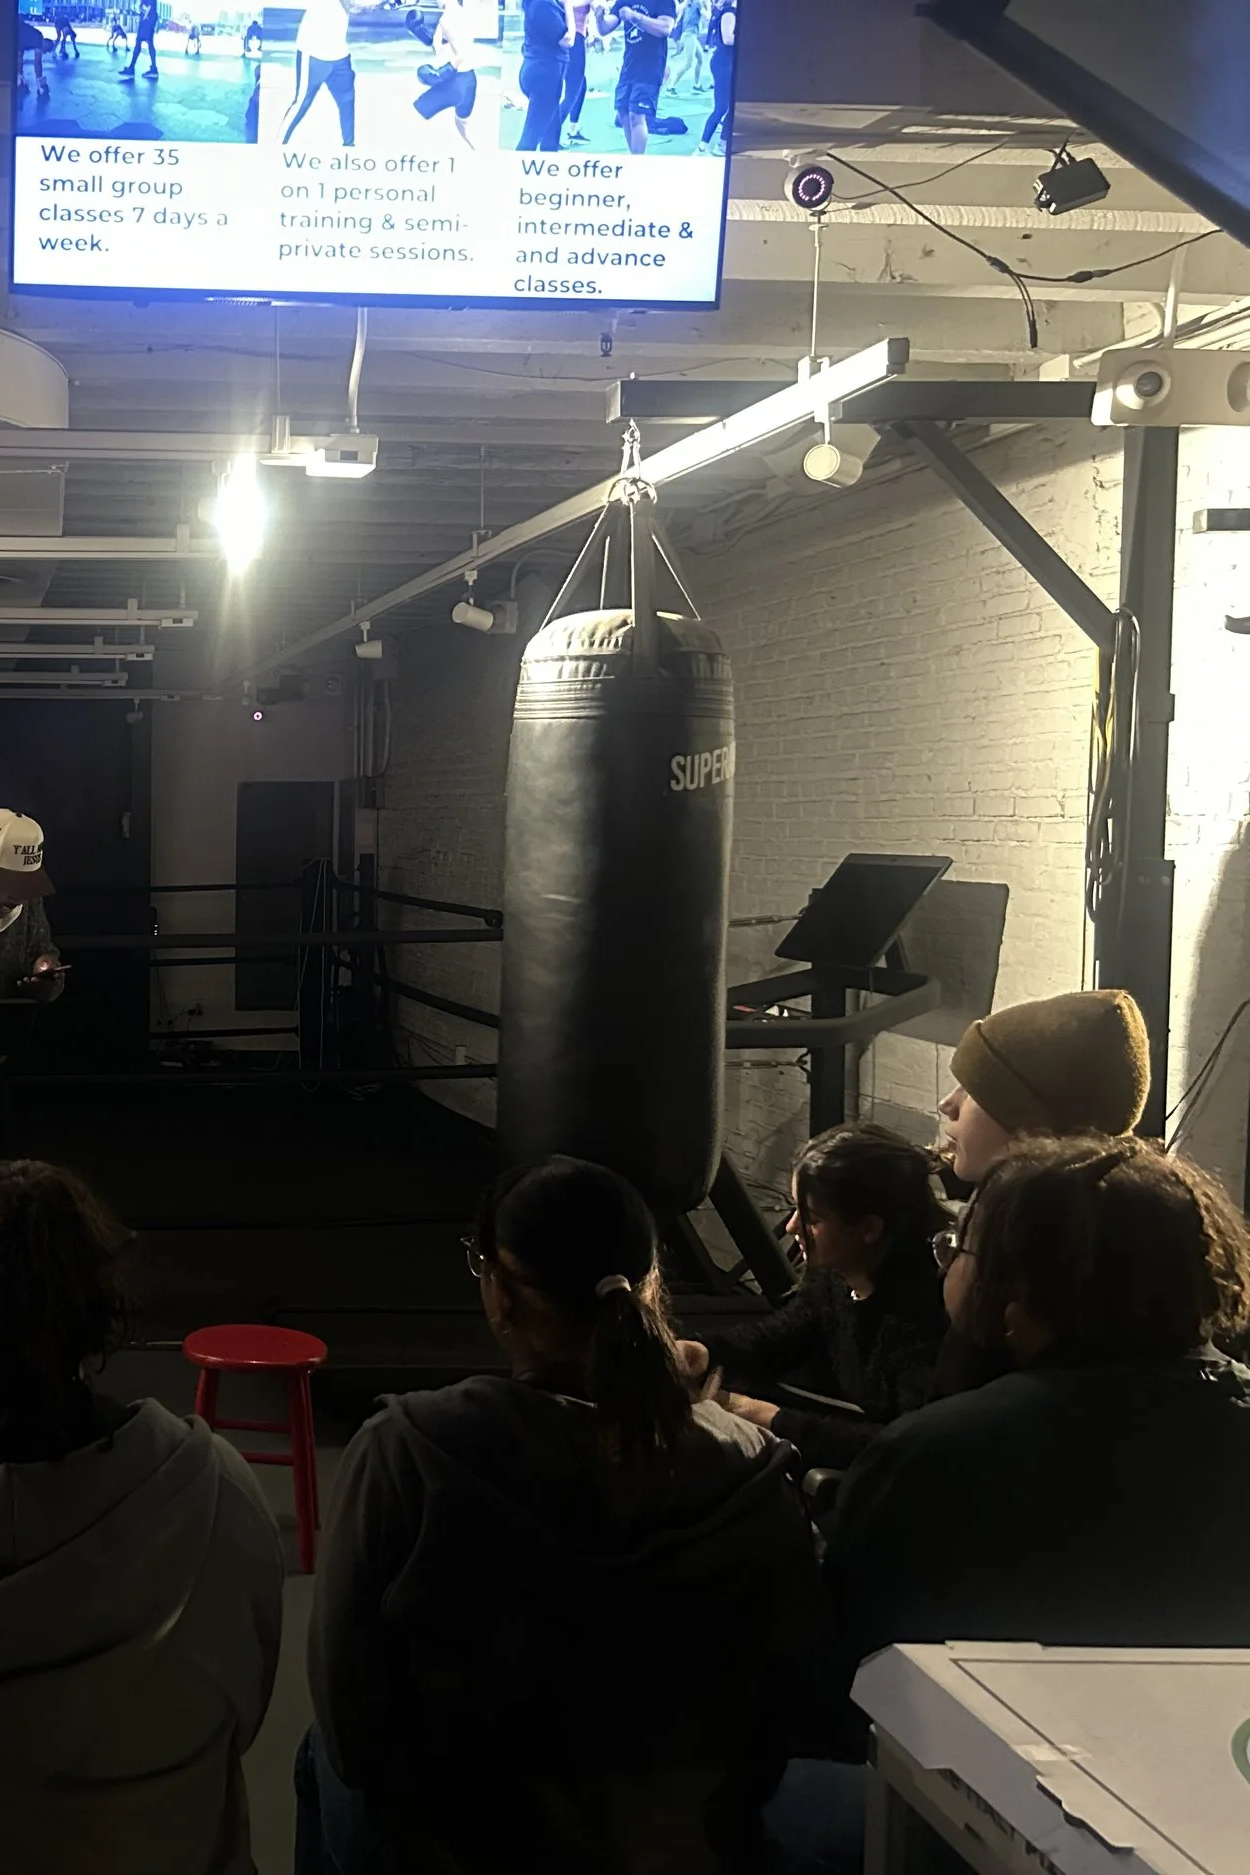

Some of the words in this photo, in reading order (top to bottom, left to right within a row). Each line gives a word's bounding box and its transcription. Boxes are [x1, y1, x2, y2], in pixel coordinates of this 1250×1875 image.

[40, 144, 82, 164] We
[88, 145, 146, 165] offer
[152, 148, 180, 166] 35
[282, 152, 322, 170] We
[329, 152, 377, 172] also
[384, 154, 441, 173] offer
[521, 159, 560, 177] We
[567, 159, 624, 180] offer
[39, 174, 103, 193] small
[111, 180, 183, 200] group
[280, 185, 309, 199] on
[317, 182, 325, 200] 1
[333, 184, 436, 205] personal
[518, 187, 631, 213] beginner,
[38, 202, 125, 224] classes
[131, 206, 146, 224] 7
[153, 206, 209, 230] days
[216, 213, 228, 227] a
[279, 209, 373, 235] training
[381, 213, 396, 231] &
[404, 213, 468, 233] semi-
[517, 215, 671, 239] intermediate
[677, 221, 694, 240] &
[38, 233, 110, 252] week.
[278, 238, 362, 261] private
[369, 241, 474, 262] sessions.
[515, 246, 559, 265] and
[566, 247, 667, 268] advance
[513, 273, 603, 295] classes.
